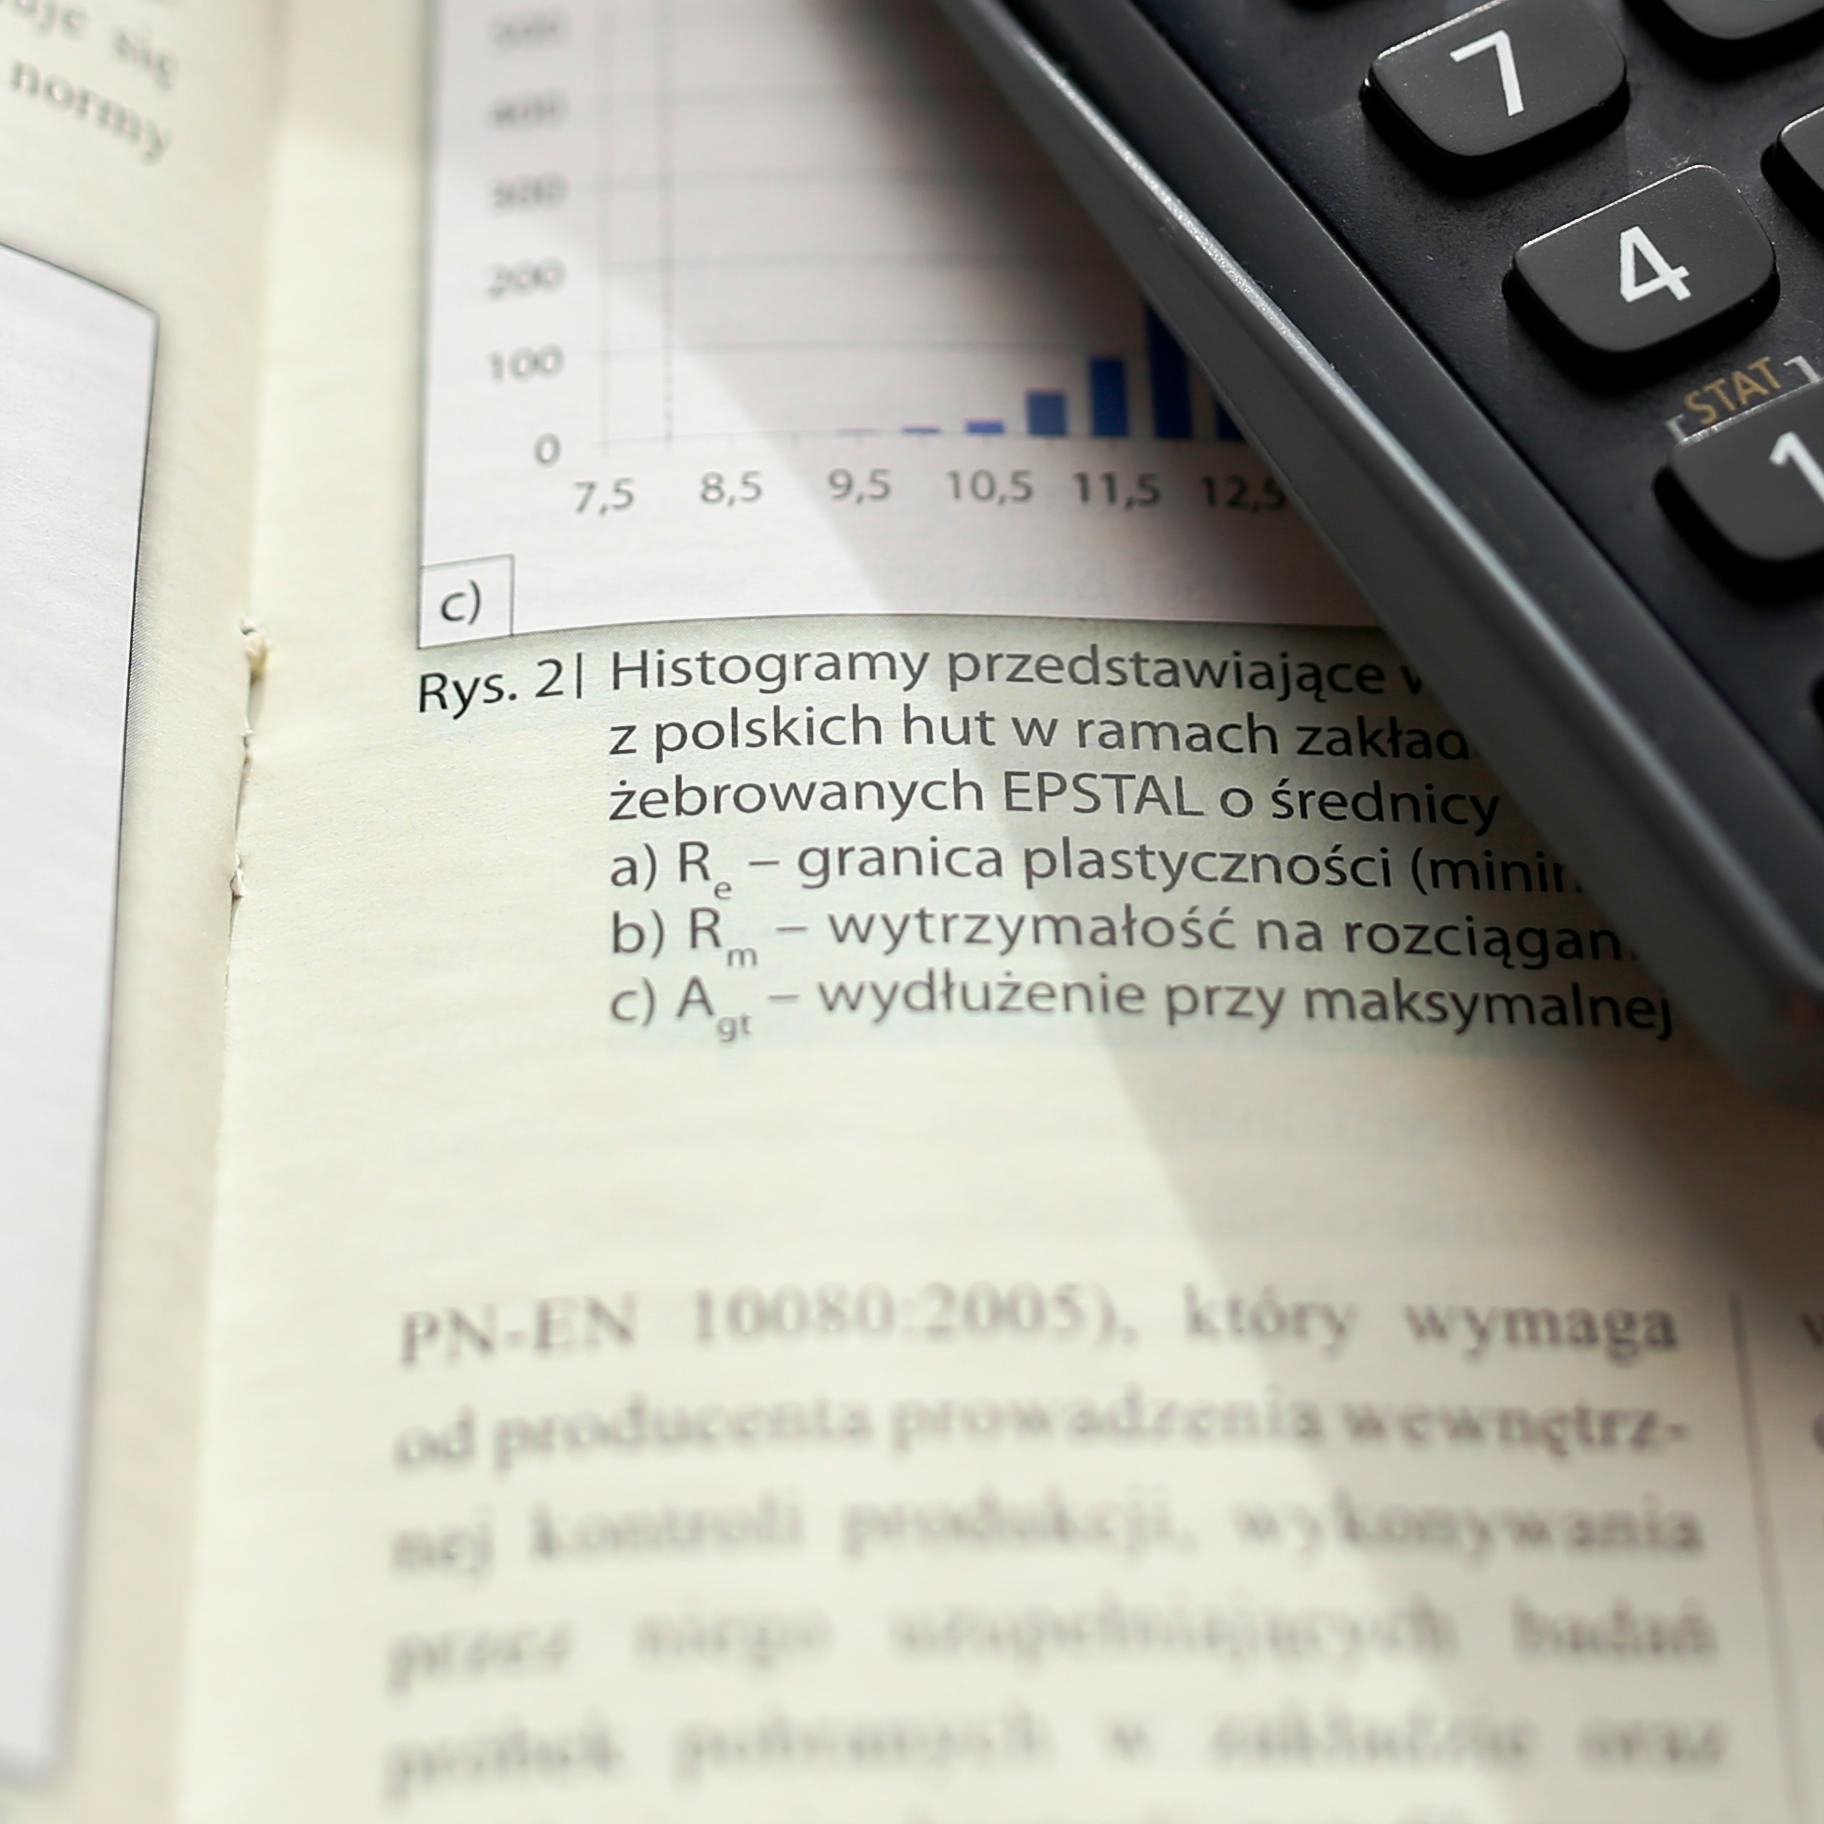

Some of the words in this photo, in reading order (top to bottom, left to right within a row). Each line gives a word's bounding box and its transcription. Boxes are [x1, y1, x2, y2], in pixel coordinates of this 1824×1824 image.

[112, 28, 180, 91] się
[1449, 29, 1526, 117] 7
[10, 58, 173, 165] normy
[488, 256, 569, 302] 200
[1618, 226, 1692, 303] 4
[488, 342, 569, 383] 100
[534, 433, 562, 469] 0
[573, 477, 635, 518] 7,5
[699, 471, 764, 508] 8,5
[828, 468, 894, 506] 9,5
[946, 469, 1036, 508] 10,5
[1071, 471, 1163, 511] 11,5
[1199, 474, 1290, 513] 12,5
[440, 581, 483, 628] c)
[418, 670, 519, 719] Rys.
[611, 644, 931, 692] Histogramy
[948, 644, 1387, 702] przedstawiające
[609, 723, 637, 755] z
[655, 703, 883, 763] polskich
[903, 705, 998, 747] hut
[1010, 714, 1058, 747] w
[1076, 711, 1278, 755] ramach
[608, 769, 984, 823] żebrowanych
[1004, 772, 1204, 817] EPSTAL
[1219, 785, 1253, 819] o
[1271, 776, 1500, 837] średnicy
[611, 844, 658, 893] a)
[797, 836, 1003, 890] granica
[1024, 835, 1392, 891] plastyczności
[612, 913, 665, 959] b)
[827, 902, 1235, 958] wytrzymałość
[1257, 917, 1321, 952] na
[611, 977, 656, 1026] c)
[818, 969, 1145, 1024] wydłużenie
[1165, 982, 1286, 1030] przy
[1304, 976, 1673, 1040] maksymalnej
[400, 1292, 640, 1369] PN-EN
[694, 1280, 1138, 1346] 10080:2005),
[1183, 1282, 1359, 1361] który
[1402, 1302, 1679, 1368] wymaga
[392, 1404, 476, 1472] od
[492, 1390, 873, 1477] producenta
[889, 1381, 1322, 1464] prowadzenia
[1339, 1399, 1689, 1465] wewnętrz-
[1234, 1484, 1706, 1575] wykonywania
